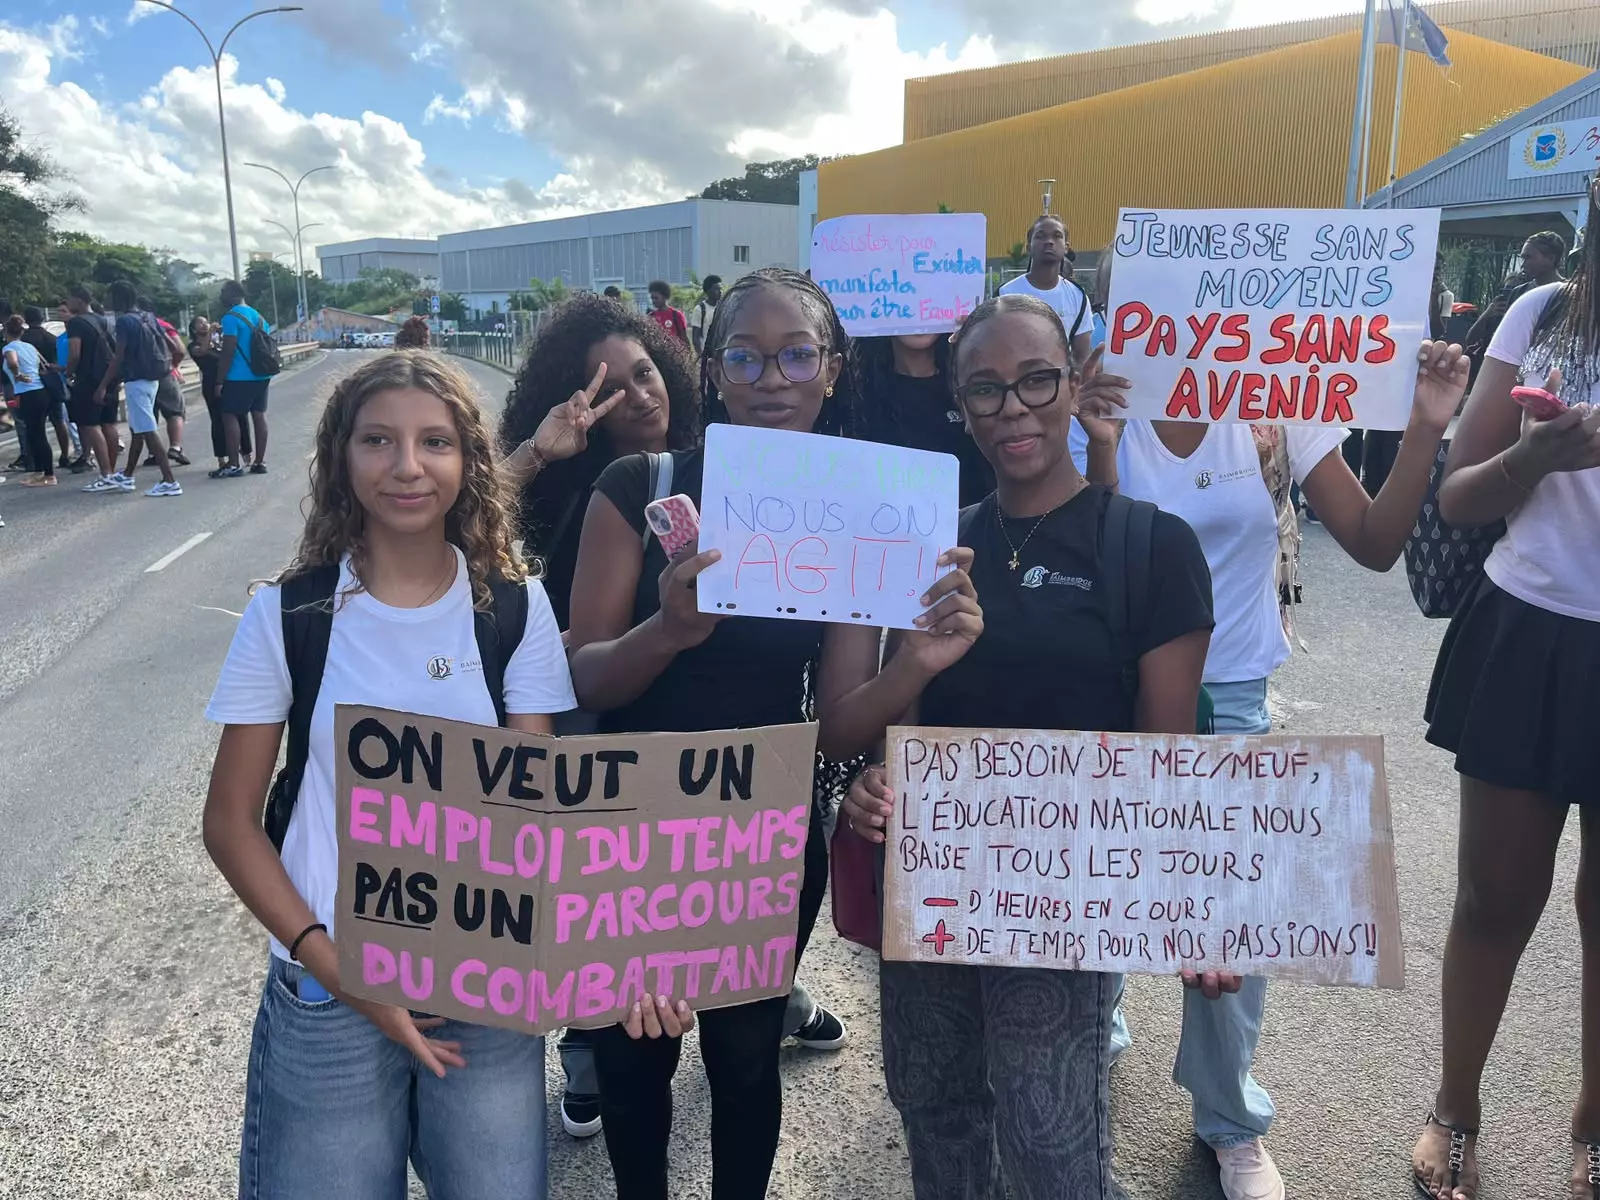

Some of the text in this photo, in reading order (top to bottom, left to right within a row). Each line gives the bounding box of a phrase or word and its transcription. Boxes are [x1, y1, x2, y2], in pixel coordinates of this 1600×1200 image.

[1115, 212, 1416, 261] JEUNESSE SANS
[871, 294, 916, 319] être
[1195, 266, 1393, 309] MOYENS
[1110, 300, 1397, 365] PAYS SANS
[724, 492, 938, 537] NOUS ON
[347, 717, 754, 806] ON VEUT UN
[903, 738, 962, 783] PAS
[1091, 745, 1128, 779] DE
[1151, 748, 1321, 785] MEC/MEUF,
[350, 786, 807, 884] EMPLOI DU TEMPS
[1252, 804, 1323, 838] NOUS
[987, 843, 1072, 879] TOUS
[1089, 846, 1141, 879] LES
[1159, 850, 1265, 882] JOURS
[354, 862, 799, 945] PAS UN PARCOURS
[967, 889, 1073, 923] D'HEURES
[1084, 898, 1113, 921] EN
[966, 928, 995, 956] DE
[1007, 927, 1087, 962] TEMPS
[1098, 929, 1153, 961] POUR
[1163, 928, 1207, 963] NOS
[361, 935, 798, 1024] DU COMBATTANT
